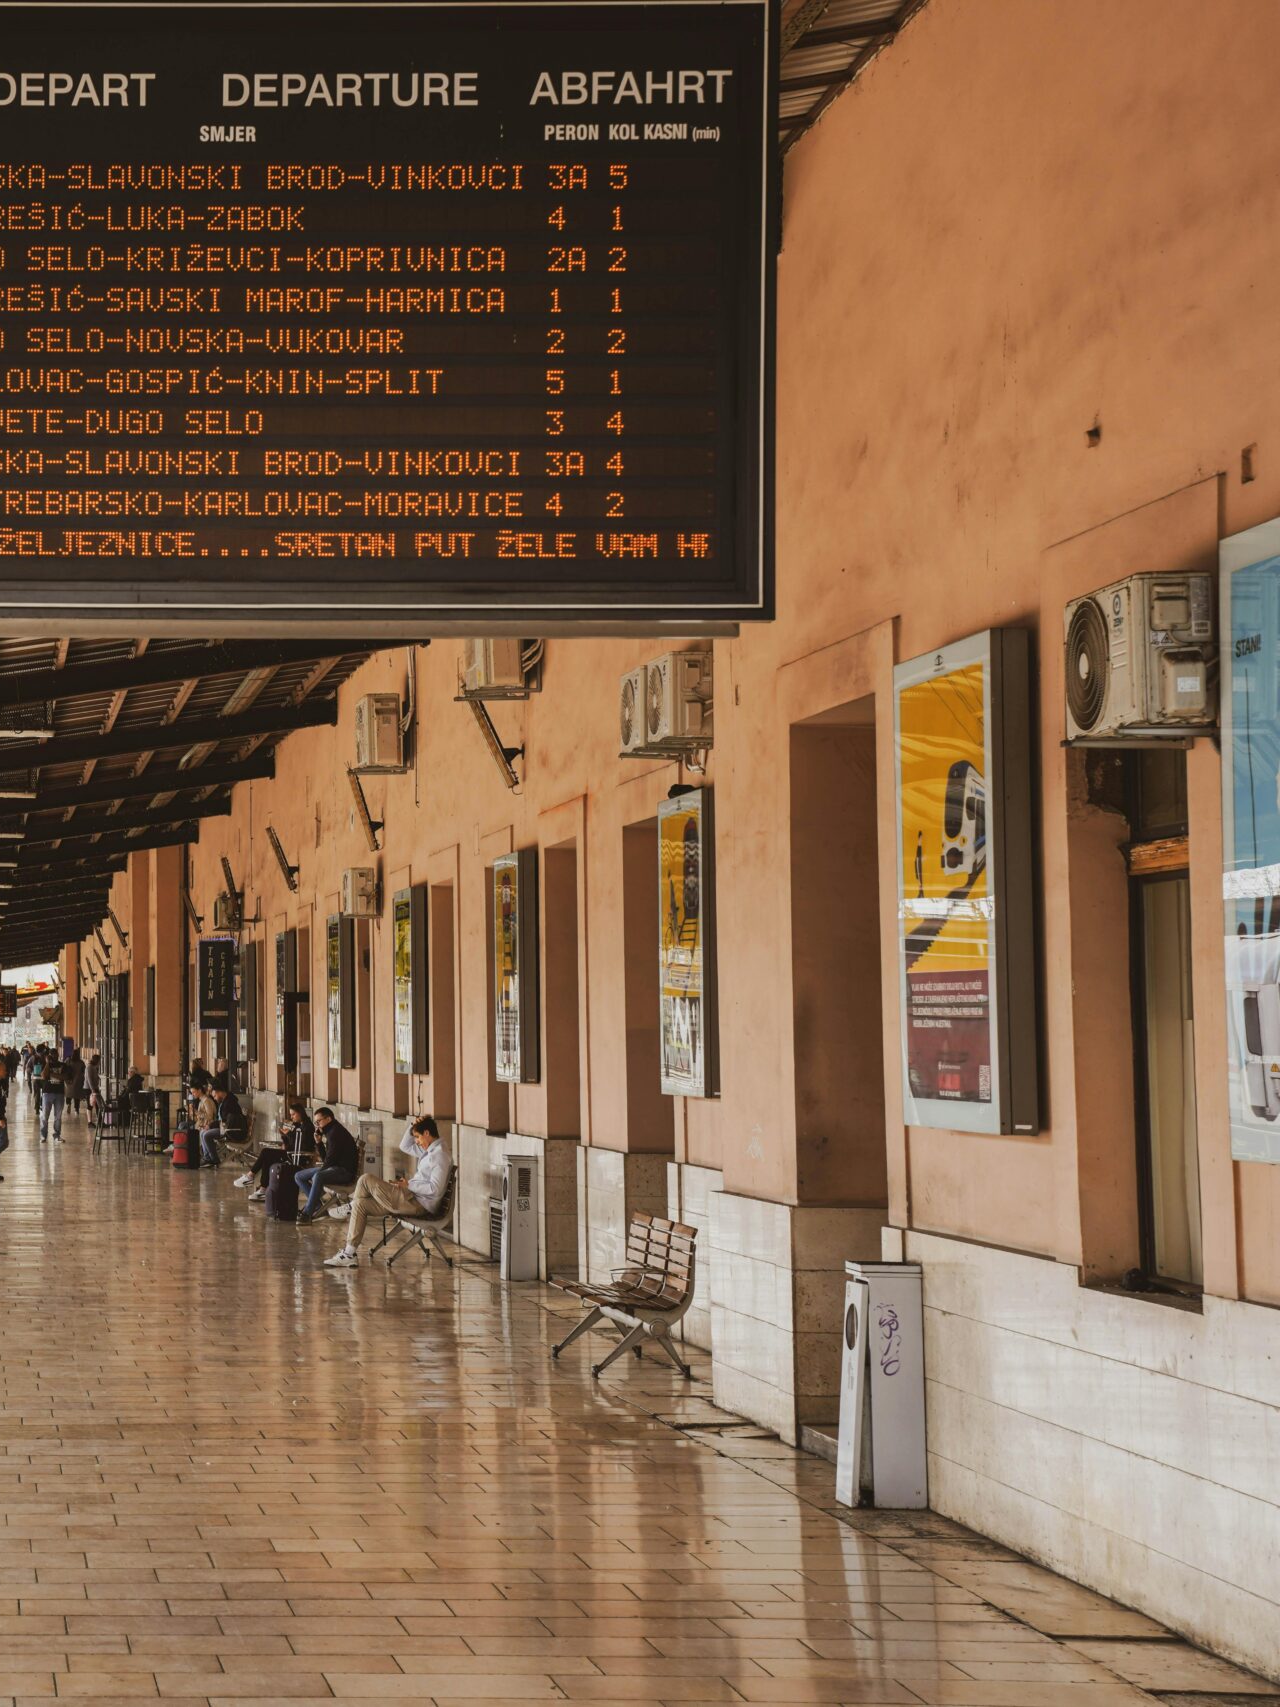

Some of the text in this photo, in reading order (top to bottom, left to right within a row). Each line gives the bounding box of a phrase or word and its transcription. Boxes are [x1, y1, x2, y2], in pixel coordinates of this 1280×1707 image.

[222, 72, 479, 107] DEPARTURE
[530, 70, 733, 105] ABFAHRT
[199, 125, 257, 143] SMJER
[544, 123, 599, 141] PERON
[608, 123, 640, 141] KOL
[643, 123, 688, 140] KASNI
[692, 126, 721, 142] (min)
[267, 164, 523, 191] BROD-VINKOVCI
[548, 164, 588, 190] 3A
[609, 164, 628, 190] 5
[547, 206, 567, 231] 4
[612, 205, 624, 231] 1
[27, 243, 506, 273] SELO-KRIŽEVCI-KOPRIVNICA
[547, 246, 587, 272] 2A
[607, 246, 627, 272] 2
[245, 287, 505, 313] MAROF-HARMICA
[550, 287, 562, 313] 1
[610, 287, 623, 313] 1
[26, 327, 404, 354] SELO-NOVSKA-VUKOVAR
[546, 328, 565, 354] 2
[607, 328, 626, 354] 2
[545, 369, 565, 395] 5
[609, 369, 622, 395] 1
[184, 409, 264, 436] SELO
[545, 410, 565, 436] 3
[606, 410, 625, 436] 4
[263, 449, 521, 477] BROD-VINKOVCI
[545, 450, 585, 477] 3A
[605, 451, 625, 477] 4
[544, 492, 564, 517] 4
[605, 491, 625, 518] 2
[414, 531, 476, 558] PUT
[495, 529, 577, 559] ŽELE
[595, 532, 659, 559] VAM
